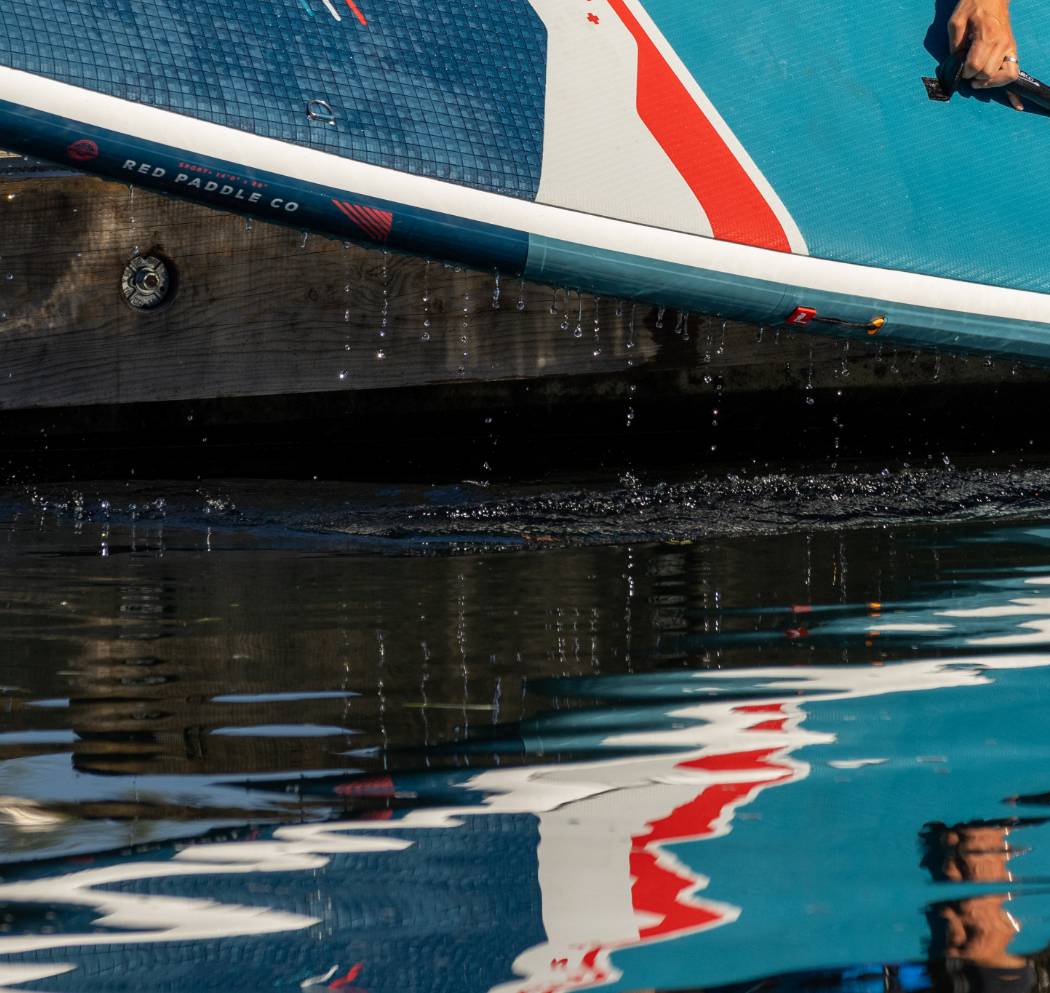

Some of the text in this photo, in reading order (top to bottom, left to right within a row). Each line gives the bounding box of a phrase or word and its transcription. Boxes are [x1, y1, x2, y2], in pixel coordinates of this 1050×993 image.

[122, 159, 166, 178] RED
[174, 173, 262, 203] PADDLE
[270, 198, 299, 212] CO
